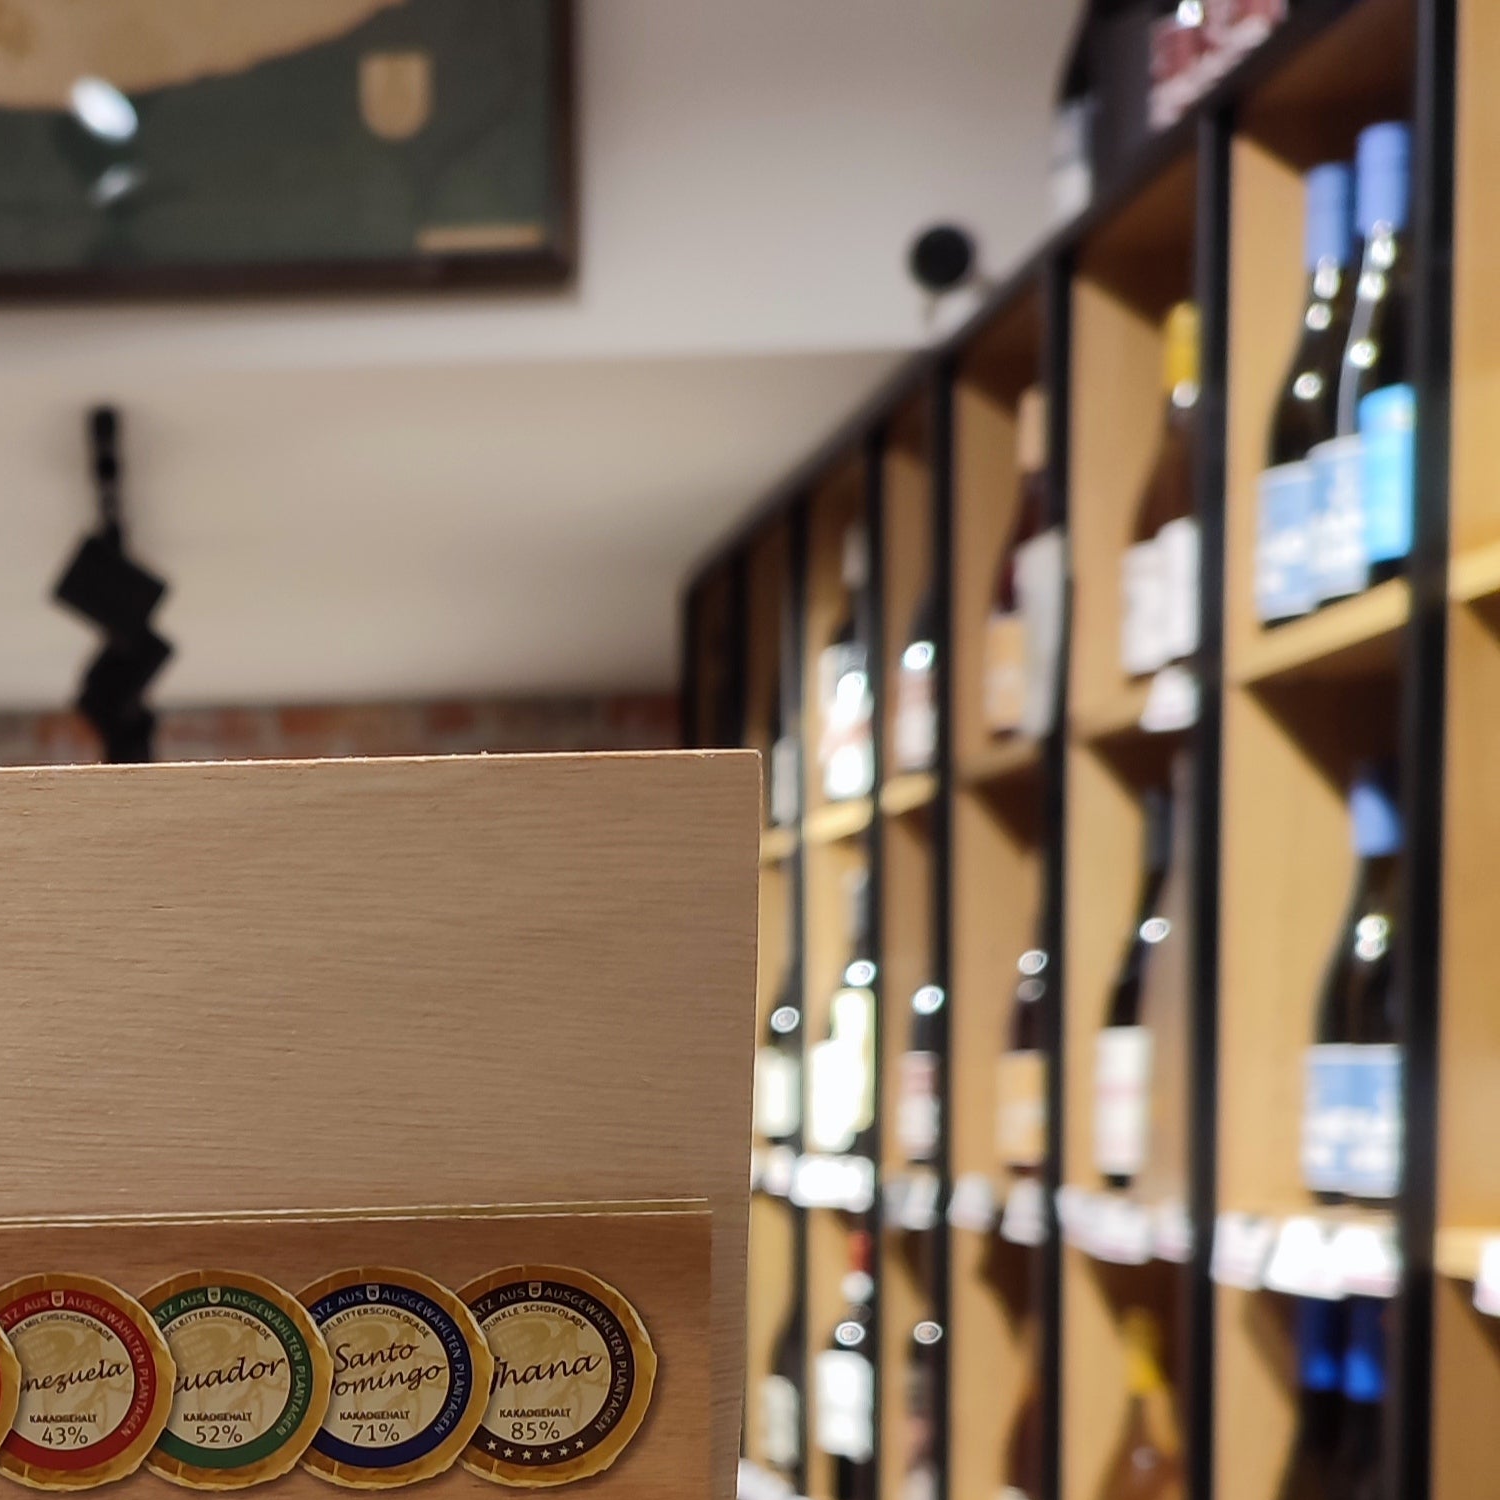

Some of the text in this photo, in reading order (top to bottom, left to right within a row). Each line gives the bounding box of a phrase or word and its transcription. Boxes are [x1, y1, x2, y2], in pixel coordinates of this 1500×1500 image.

[482, 1304, 588, 1333] DUNKLE SCHOKOLADE
[24, 1295, 49, 1312] AUS
[121, 1366, 149, 1437] PLANTAGEN
[180, 1293, 206, 1308] AUS
[276, 1365, 307, 1436] PLANTAGEN
[334, 1342, 420, 1374] Santo
[337, 1289, 364, 1306] AUS
[434, 1362, 465, 1435] PLANTAGEN
[500, 1289, 526, 1304] AUS
[594, 1359, 628, 1433] PLANTAGEN
[333, 1363, 446, 1397] omingo
[30, 1414, 97, 1423] KAKAOGEHALT
[183, 1412, 252, 1422] KAKAOGEHALT
[340, 1411, 410, 1420] KAKAOGEHALT
[500, 1408, 572, 1418] KAKAOGEHALT
[41, 1426, 88, 1445] 43%
[196, 1424, 243, 1444] 52%
[352, 1423, 400, 1443] 71%
[511, 1421, 560, 1441] 85%
